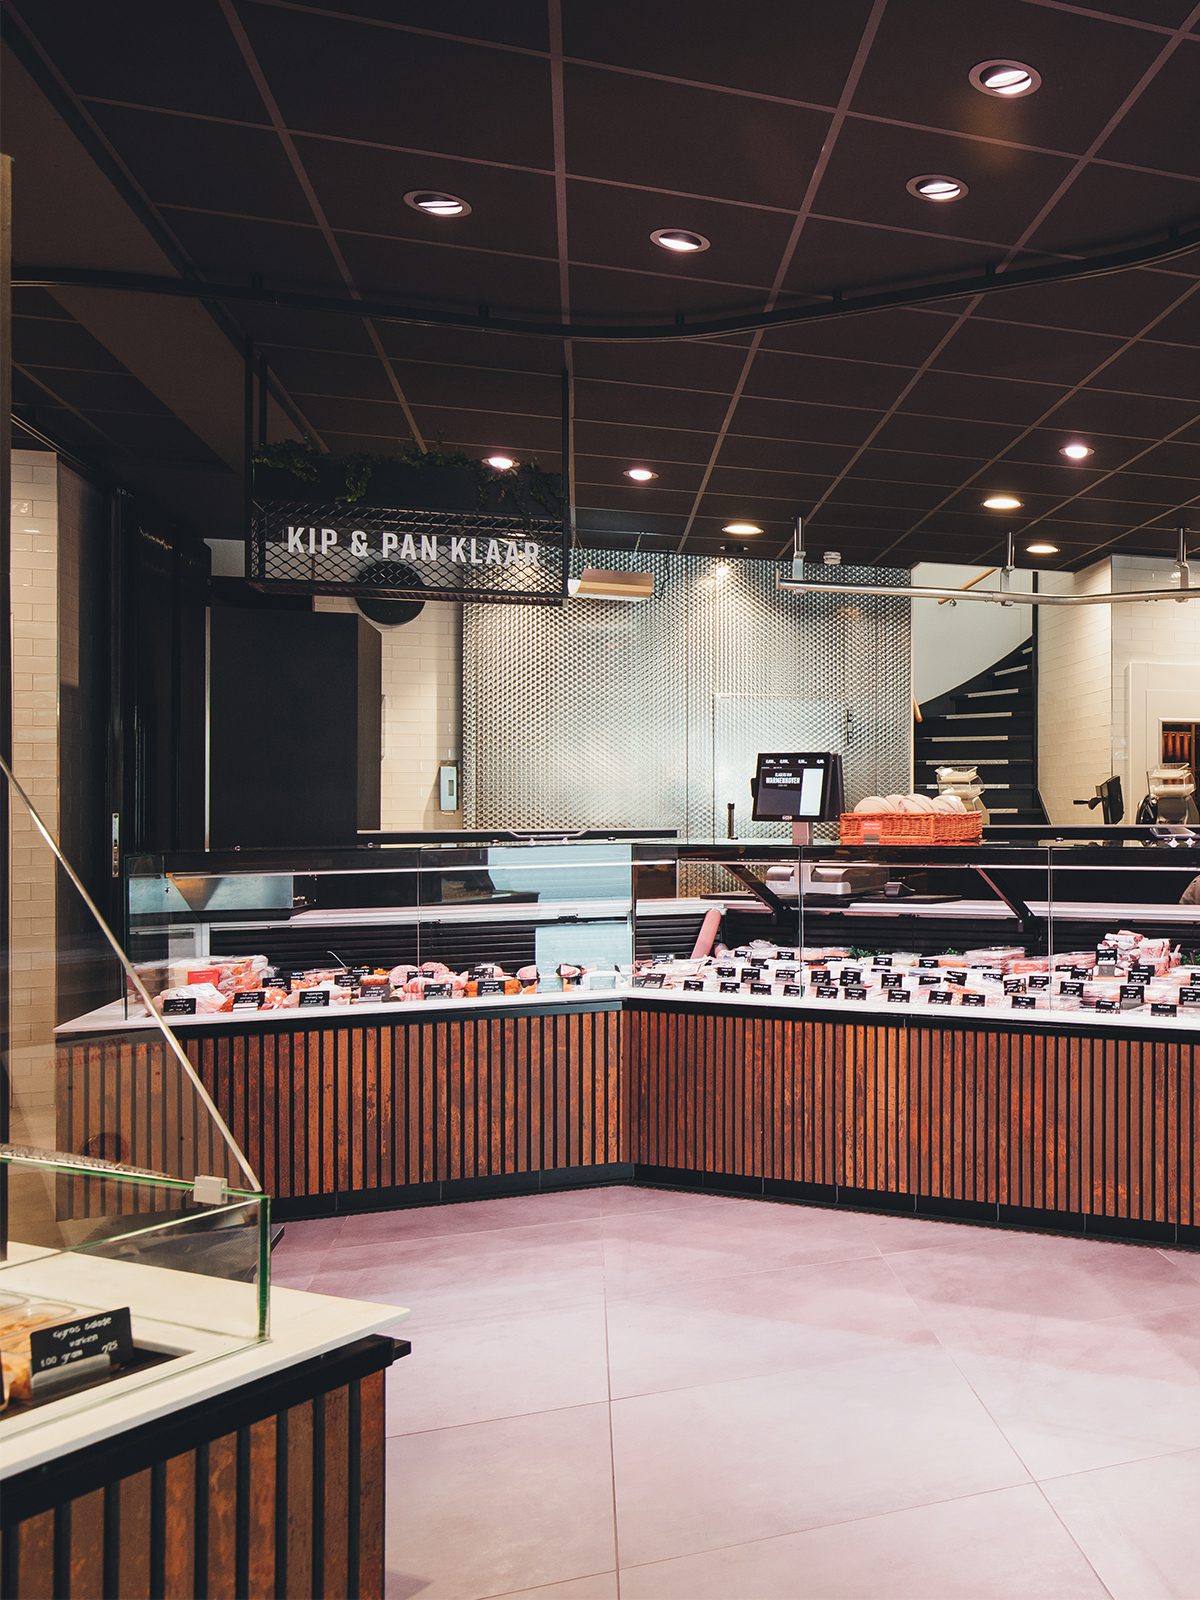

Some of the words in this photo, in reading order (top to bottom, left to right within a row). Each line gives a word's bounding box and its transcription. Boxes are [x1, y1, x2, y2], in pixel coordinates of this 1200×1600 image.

[287, 526, 338, 555] KIP
[351, 530, 369, 557] &
[382, 532, 437, 561] PAN
[451, 537, 540, 567] KLAAR
[40, 1355, 57, 1368] 100
[61, 1349, 83, 1365] gram
